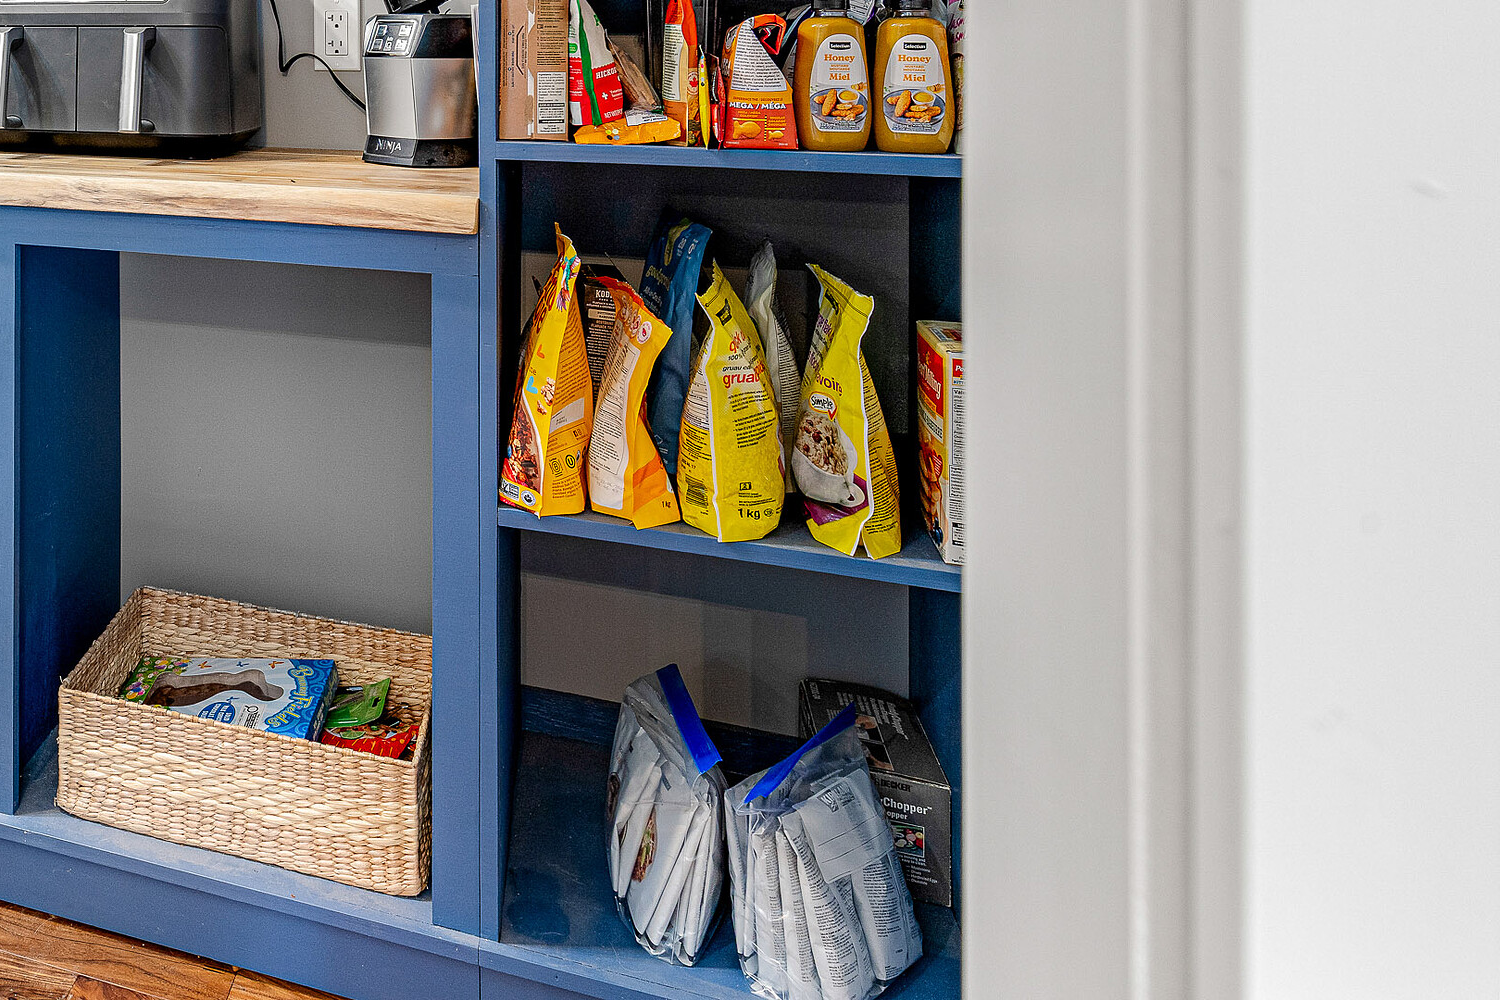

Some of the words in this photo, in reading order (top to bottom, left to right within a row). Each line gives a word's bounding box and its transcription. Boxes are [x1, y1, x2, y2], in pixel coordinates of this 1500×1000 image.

[824, 53, 855, 63] Honey
[898, 54, 931, 64] Honey
[903, 73, 926, 82] Miel
[761, 101, 787, 109] MÉGA
[376, 138, 402, 154] NINJA
[738, 508, 744, 518] 1
[746, 508, 761, 520] kg
[268, 697, 312, 728] Fields
[881, 778, 911, 792] DECKER
[886, 811, 908, 820] opper
